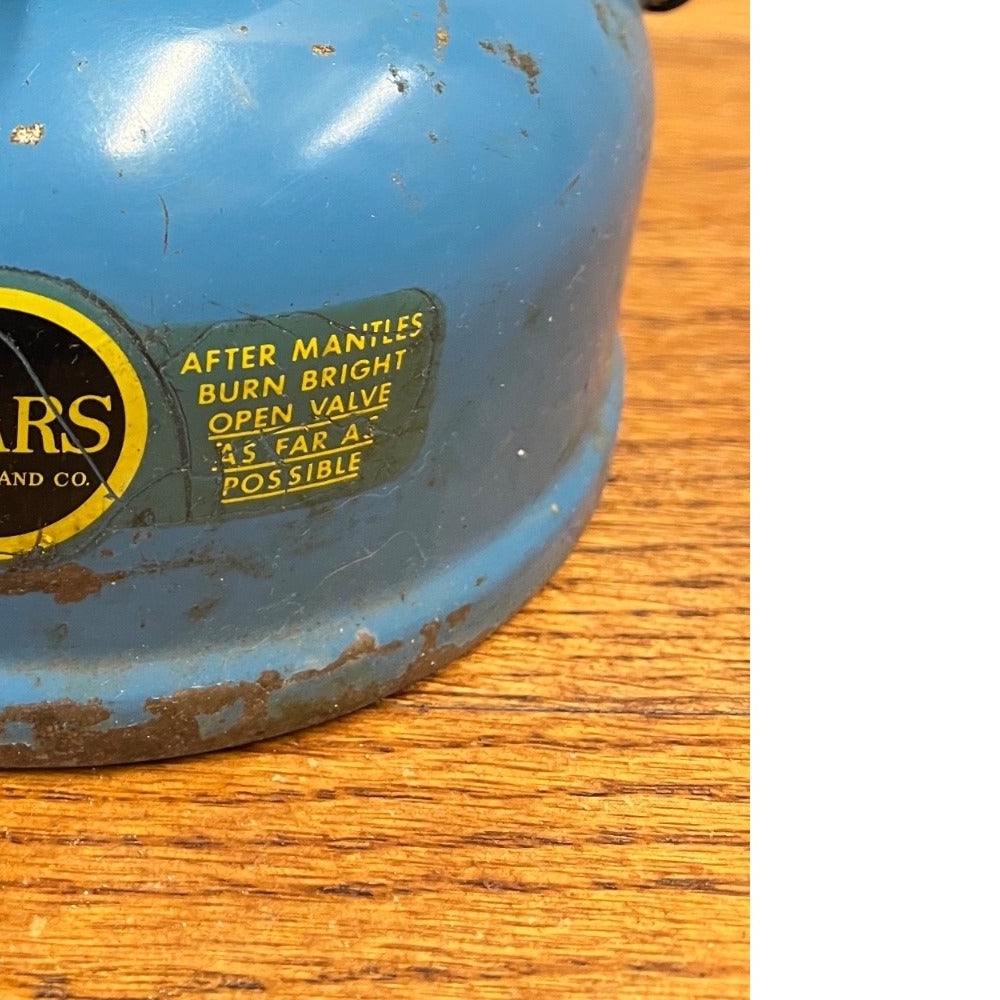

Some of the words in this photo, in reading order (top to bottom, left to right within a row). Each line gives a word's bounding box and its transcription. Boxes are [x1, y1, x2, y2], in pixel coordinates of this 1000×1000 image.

[180, 343, 276, 375] AFTER
[292, 312, 423, 362] MANTLES
[198, 374, 286, 405] BURN
[301, 349, 407, 392] BRIGHT
[208, 403, 293, 434] OPEN
[310, 382, 392, 420] VALVE
[211, 441, 257, 472] AS
[276, 431, 328, 456] FAR
[222, 451, 362, 497] POSSIBLE
[53, 471, 90, 487] CO.
